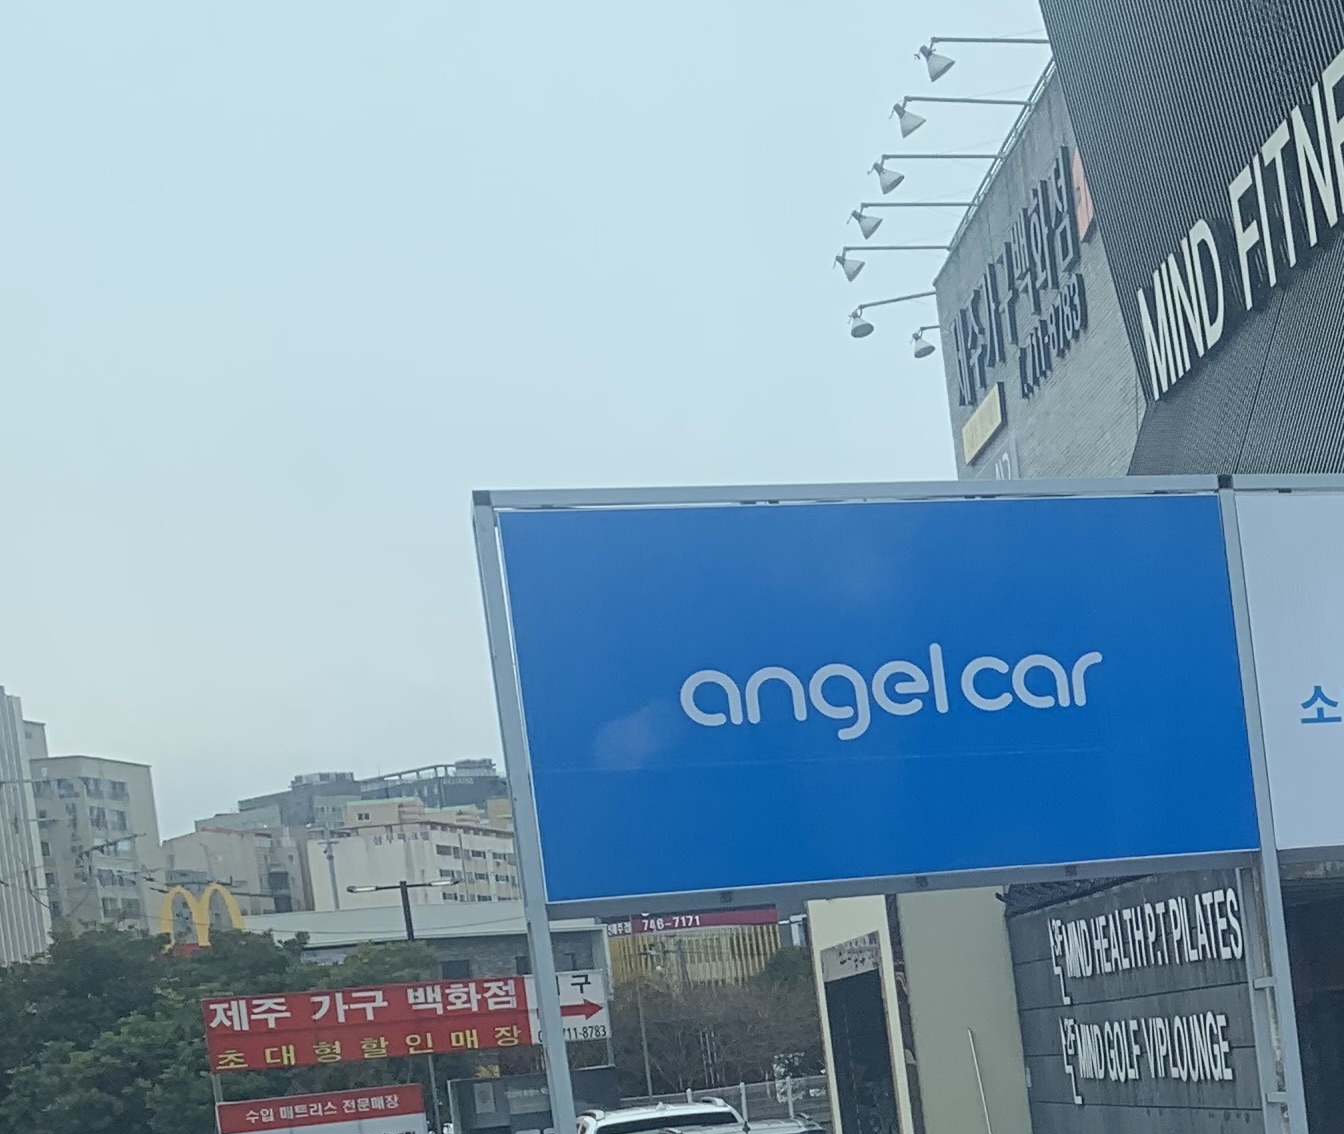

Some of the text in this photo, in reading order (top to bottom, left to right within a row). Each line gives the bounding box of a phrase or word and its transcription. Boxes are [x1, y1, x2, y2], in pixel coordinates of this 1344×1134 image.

[1137, 219, 1224, 400] MIND
[1062, 919, 1093, 978] MIND
[1091, 906, 1147, 975] HEALTH
[1169, 887, 1243, 965] PILATES
[209, 998, 291, 1031] 제주
[310, 991, 388, 1024] 가구
[407, 980, 517, 1015] 백화점
[1075, 1023, 1105, 1080] MIND
[1104, 1020, 1141, 1083] GOLF
[245, 1094, 399, 1124] 수입 매트리스 전문매장
